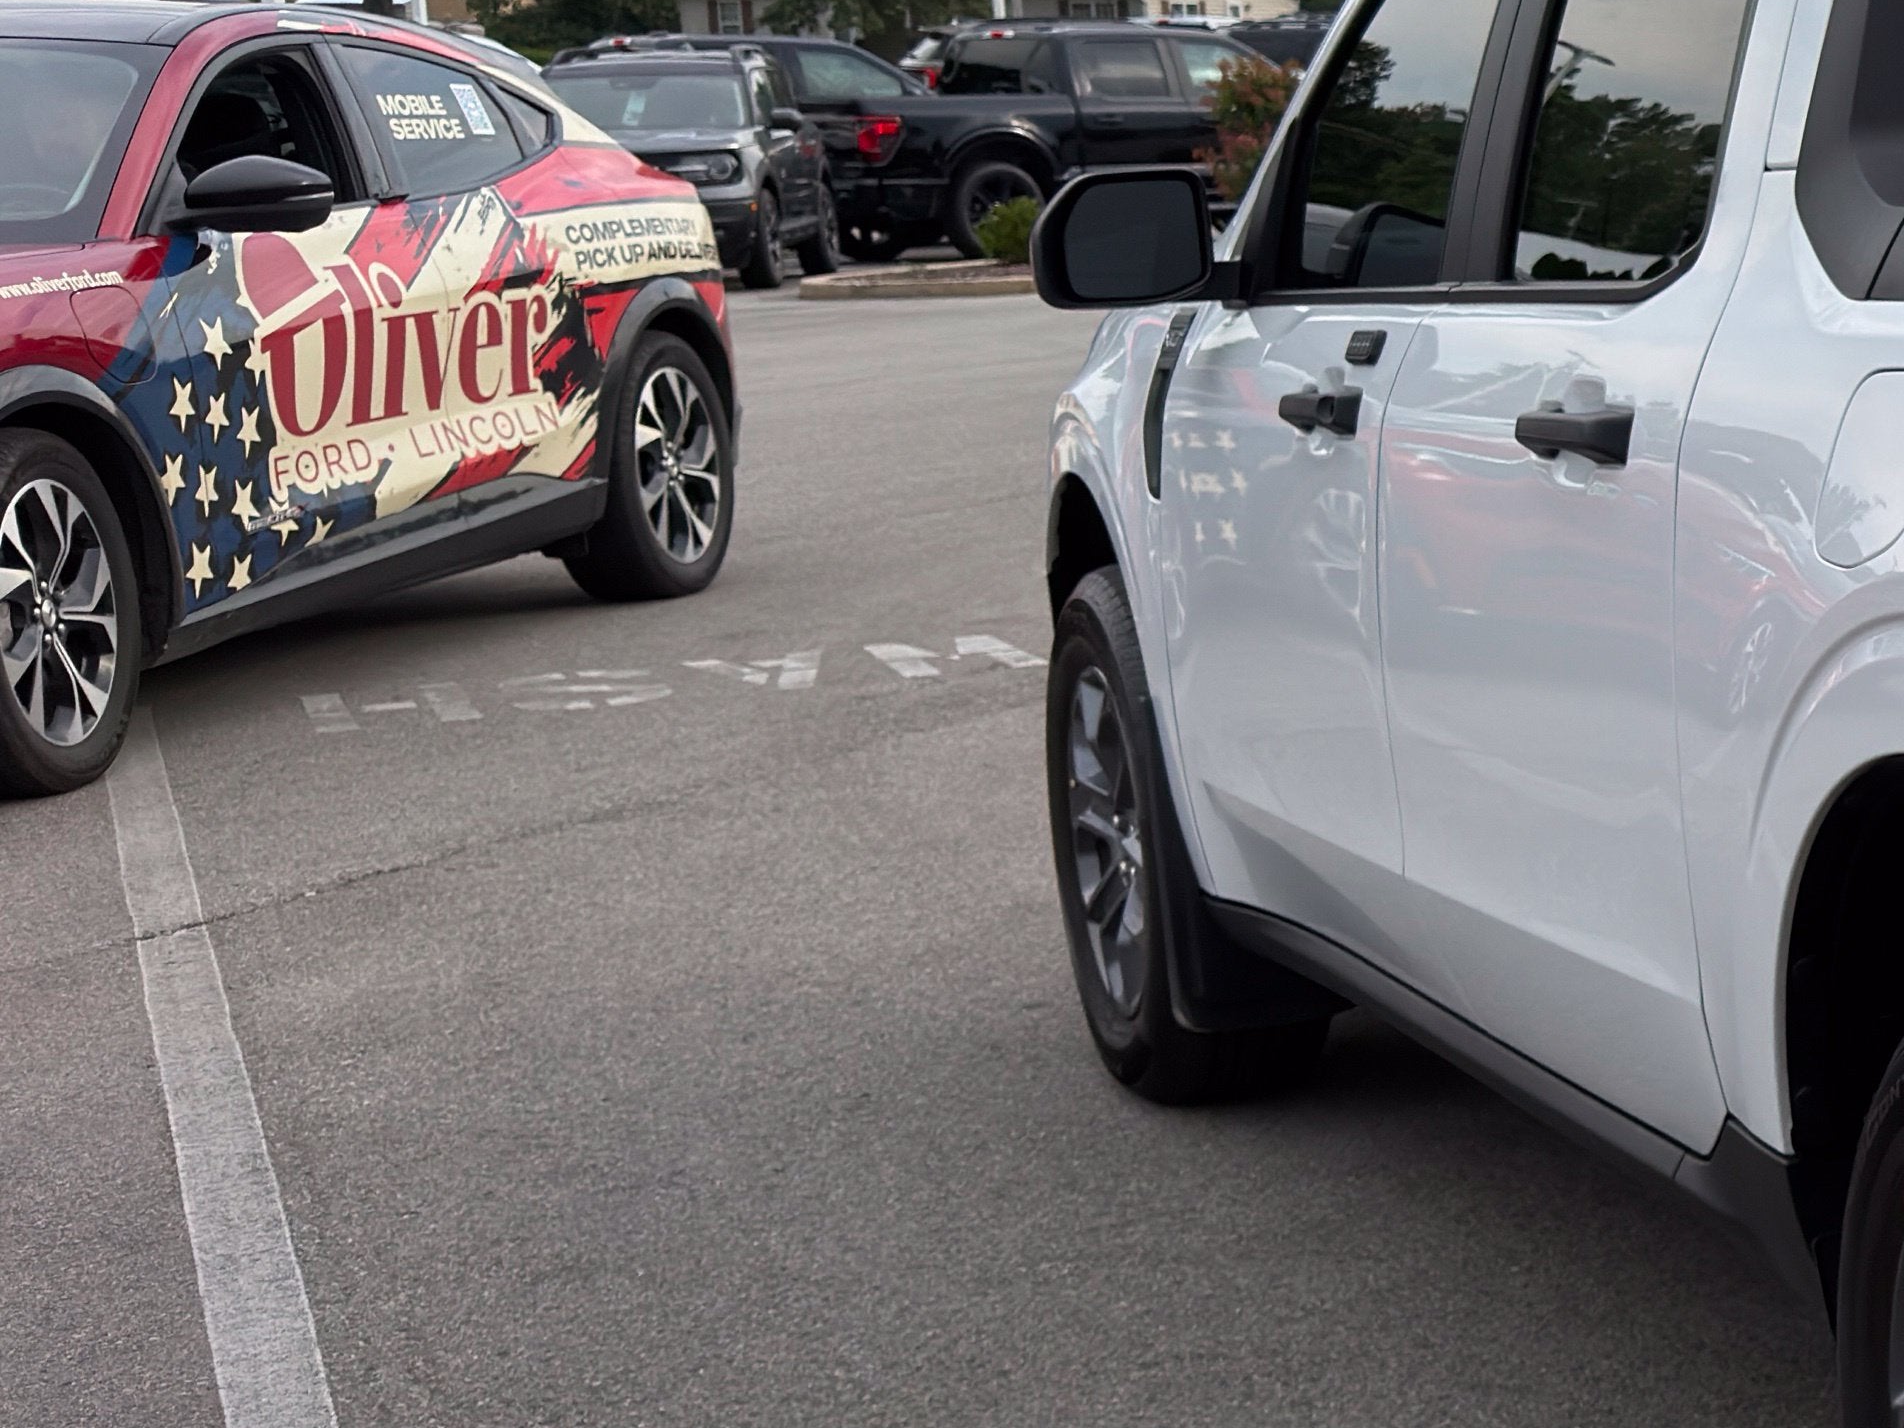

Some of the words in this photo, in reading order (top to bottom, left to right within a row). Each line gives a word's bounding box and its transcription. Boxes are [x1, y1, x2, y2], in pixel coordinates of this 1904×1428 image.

[375, 94, 447, 115] MOBILE
[389, 118, 465, 140] SERVICE
[565, 217, 698, 244] COMPLEMENTARY
[575, 246, 620, 271] PICK
[620, 243, 645, 264] UP
[648, 240, 678, 260] AND
[0, 269, 125, 299] www.oliverford.com
[241, 232, 549, 437] Oliver
[273, 438, 373, 490] FORD
[409, 400, 560, 459] LINCOLN
